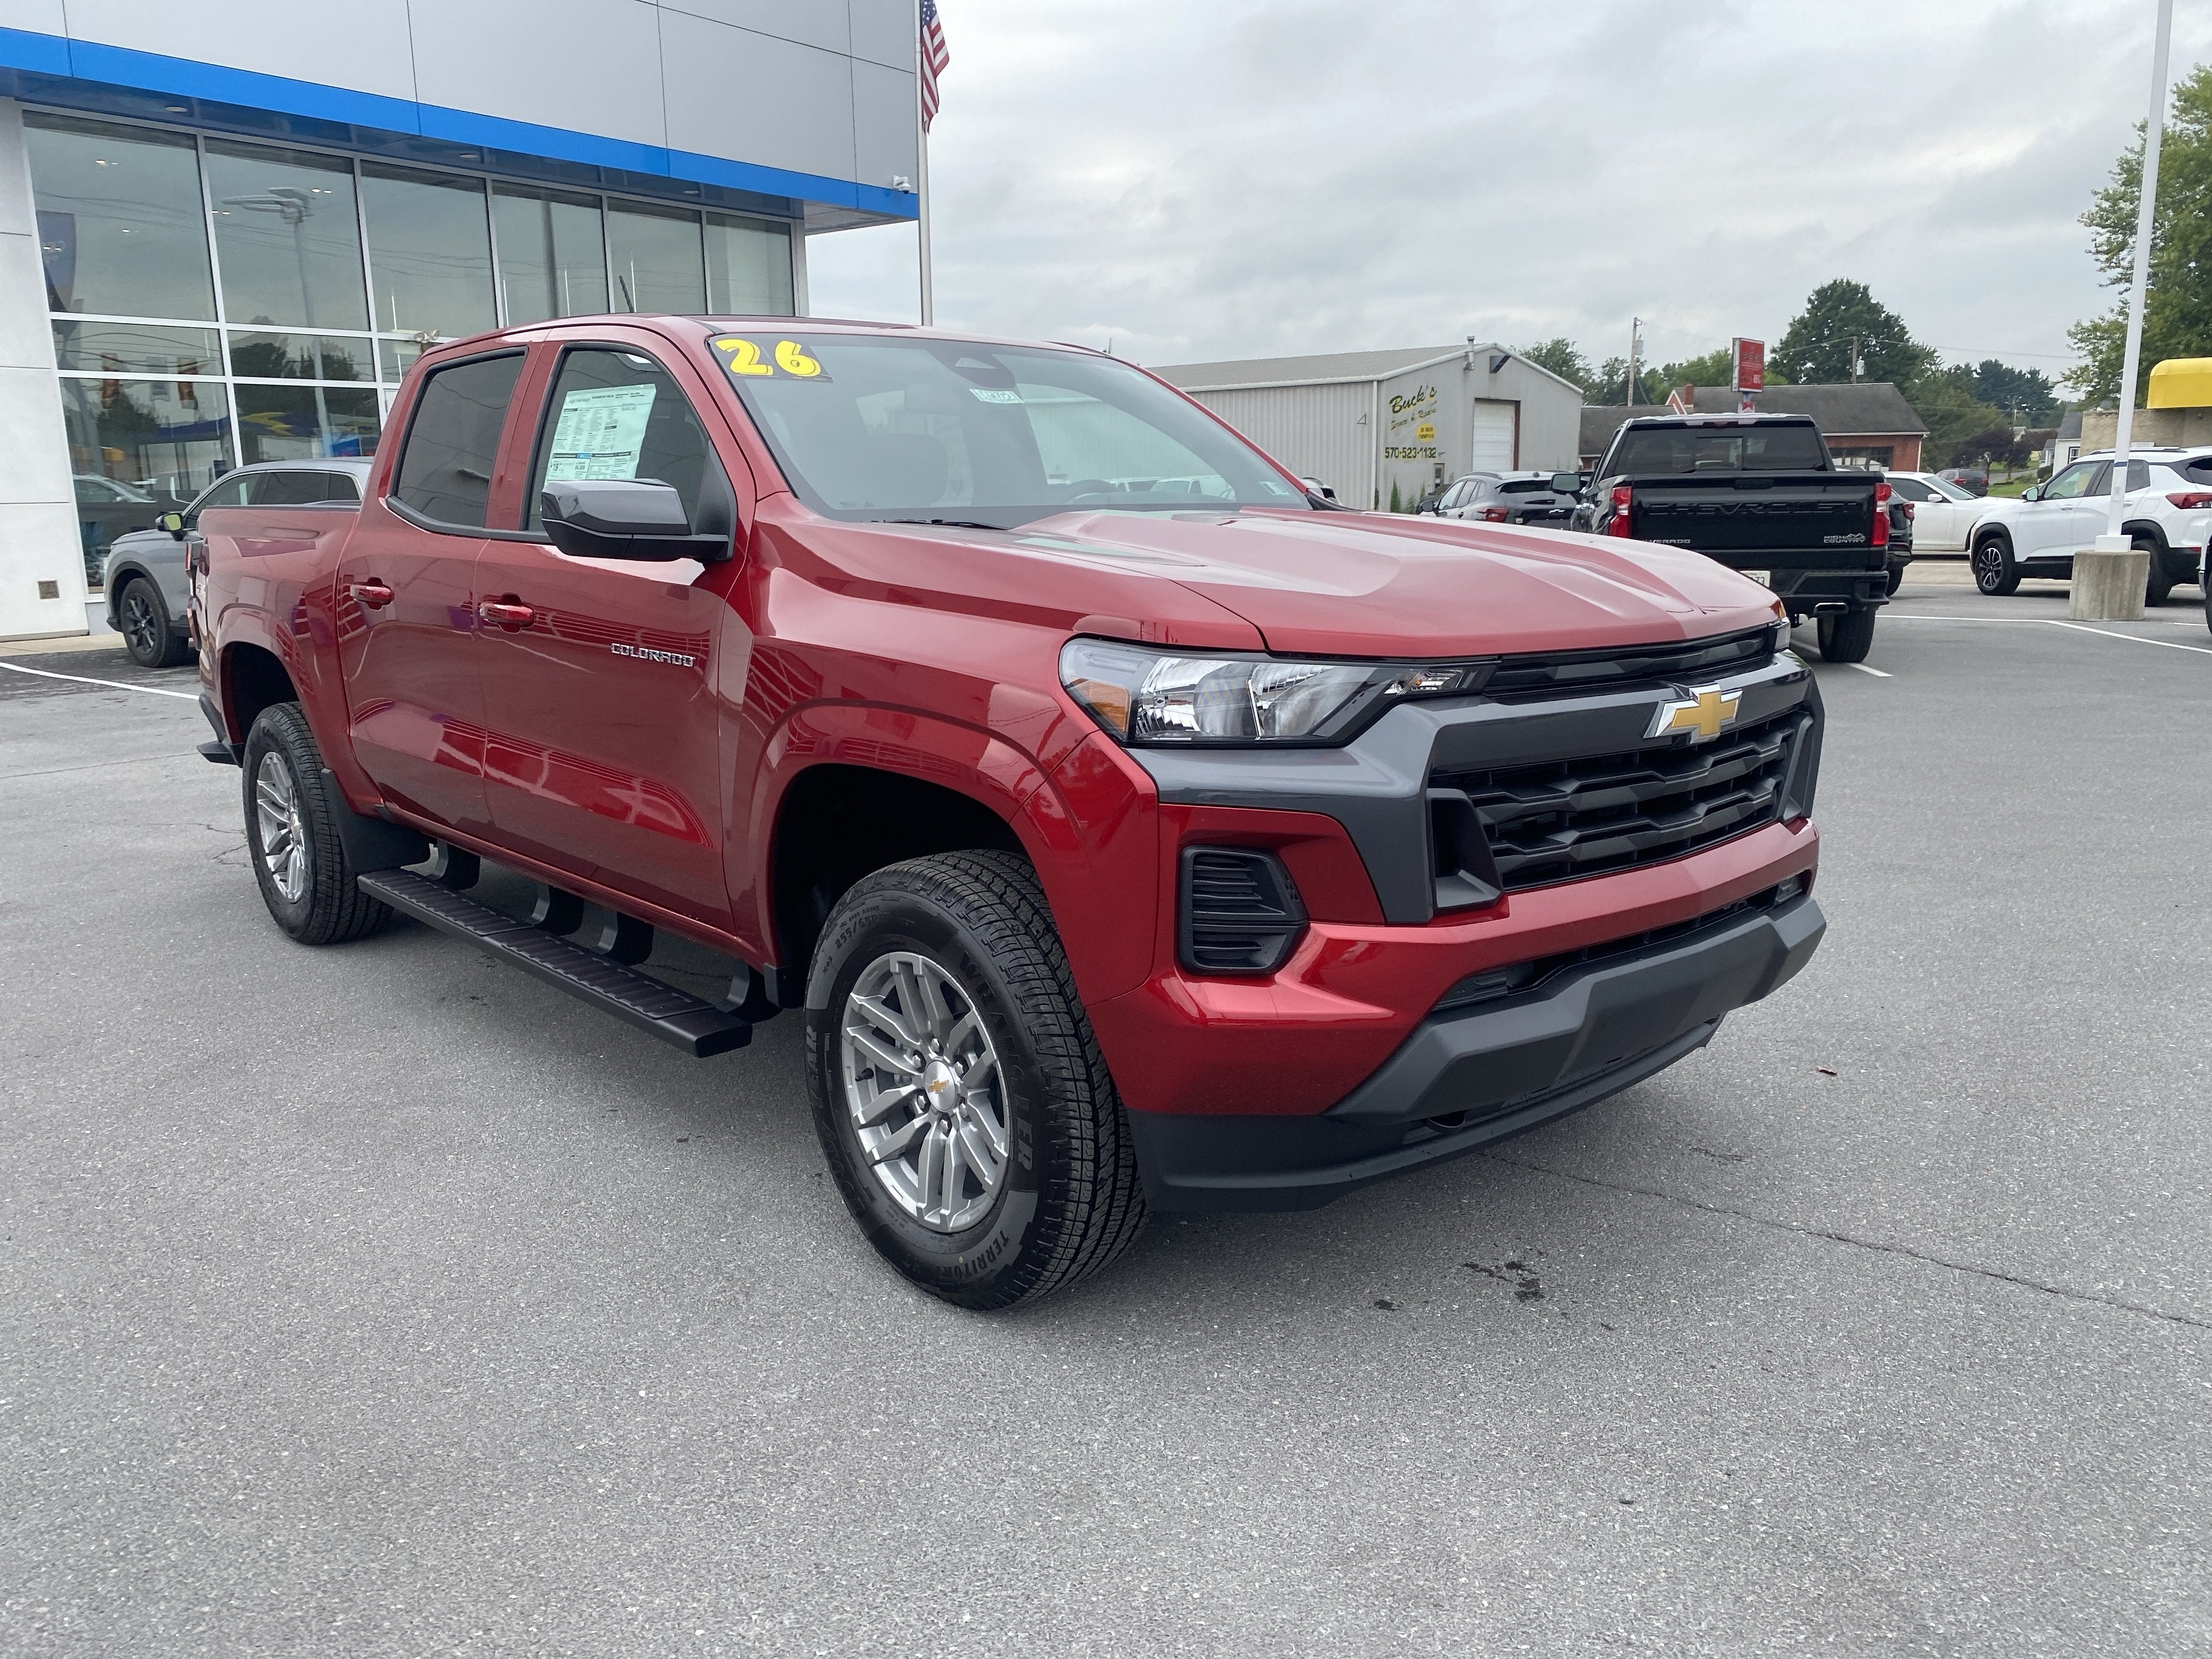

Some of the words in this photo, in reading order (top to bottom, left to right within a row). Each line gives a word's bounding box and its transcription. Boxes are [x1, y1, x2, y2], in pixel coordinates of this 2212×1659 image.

[715, 338, 821, 377] 26
[1389, 385, 1438, 414] Buck's
[1385, 447, 1437, 459] 570-523-1132
[611, 642, 694, 668] COLORADO
